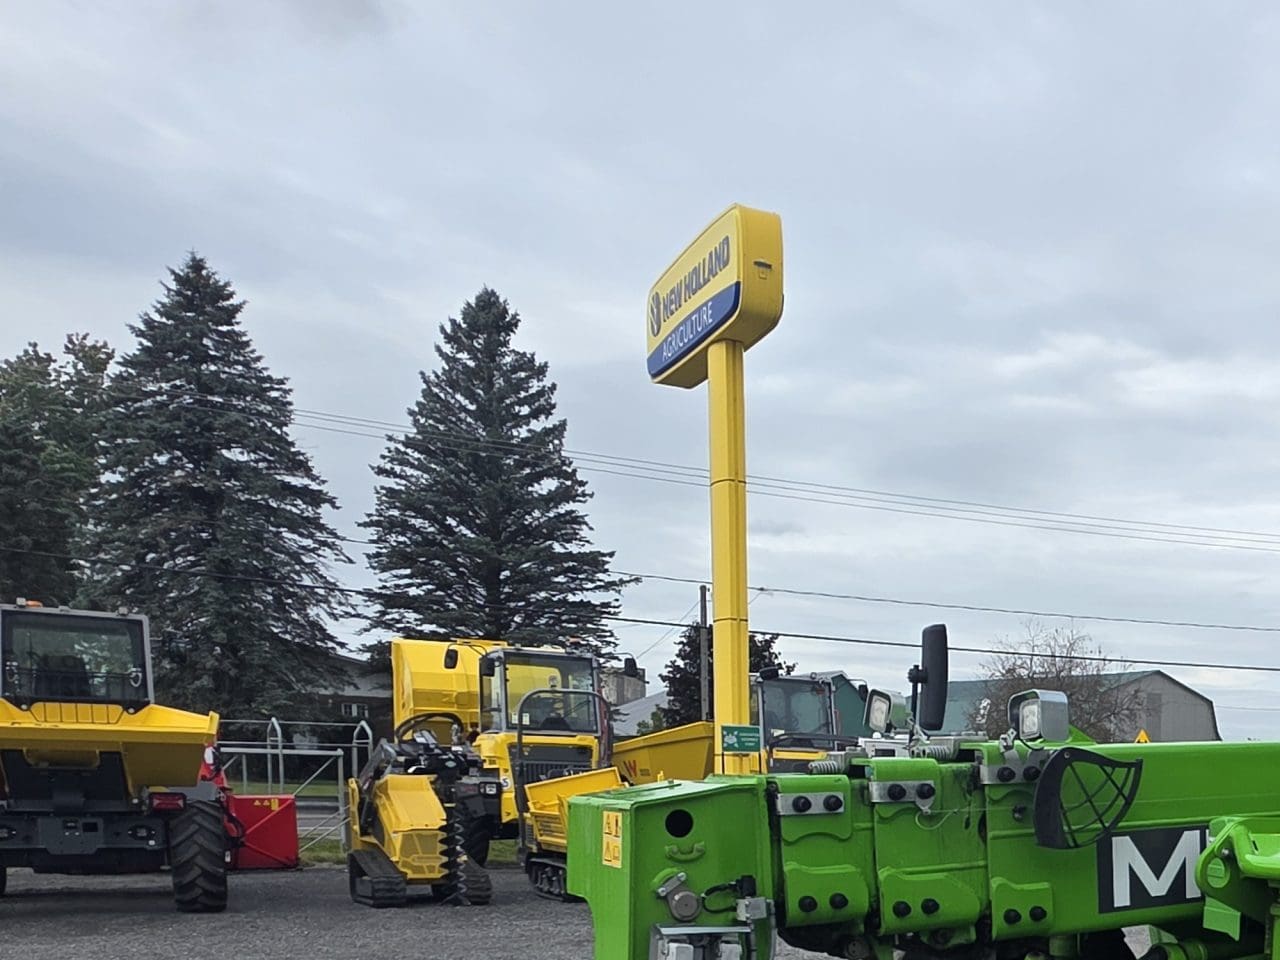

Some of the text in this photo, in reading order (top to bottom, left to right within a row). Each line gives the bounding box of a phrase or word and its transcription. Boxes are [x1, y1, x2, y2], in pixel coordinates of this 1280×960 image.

[662, 236, 730, 322] NEW HOLLAND
[662, 301, 713, 362] AGRICULTURE
[1111, 829, 1211, 908] M
